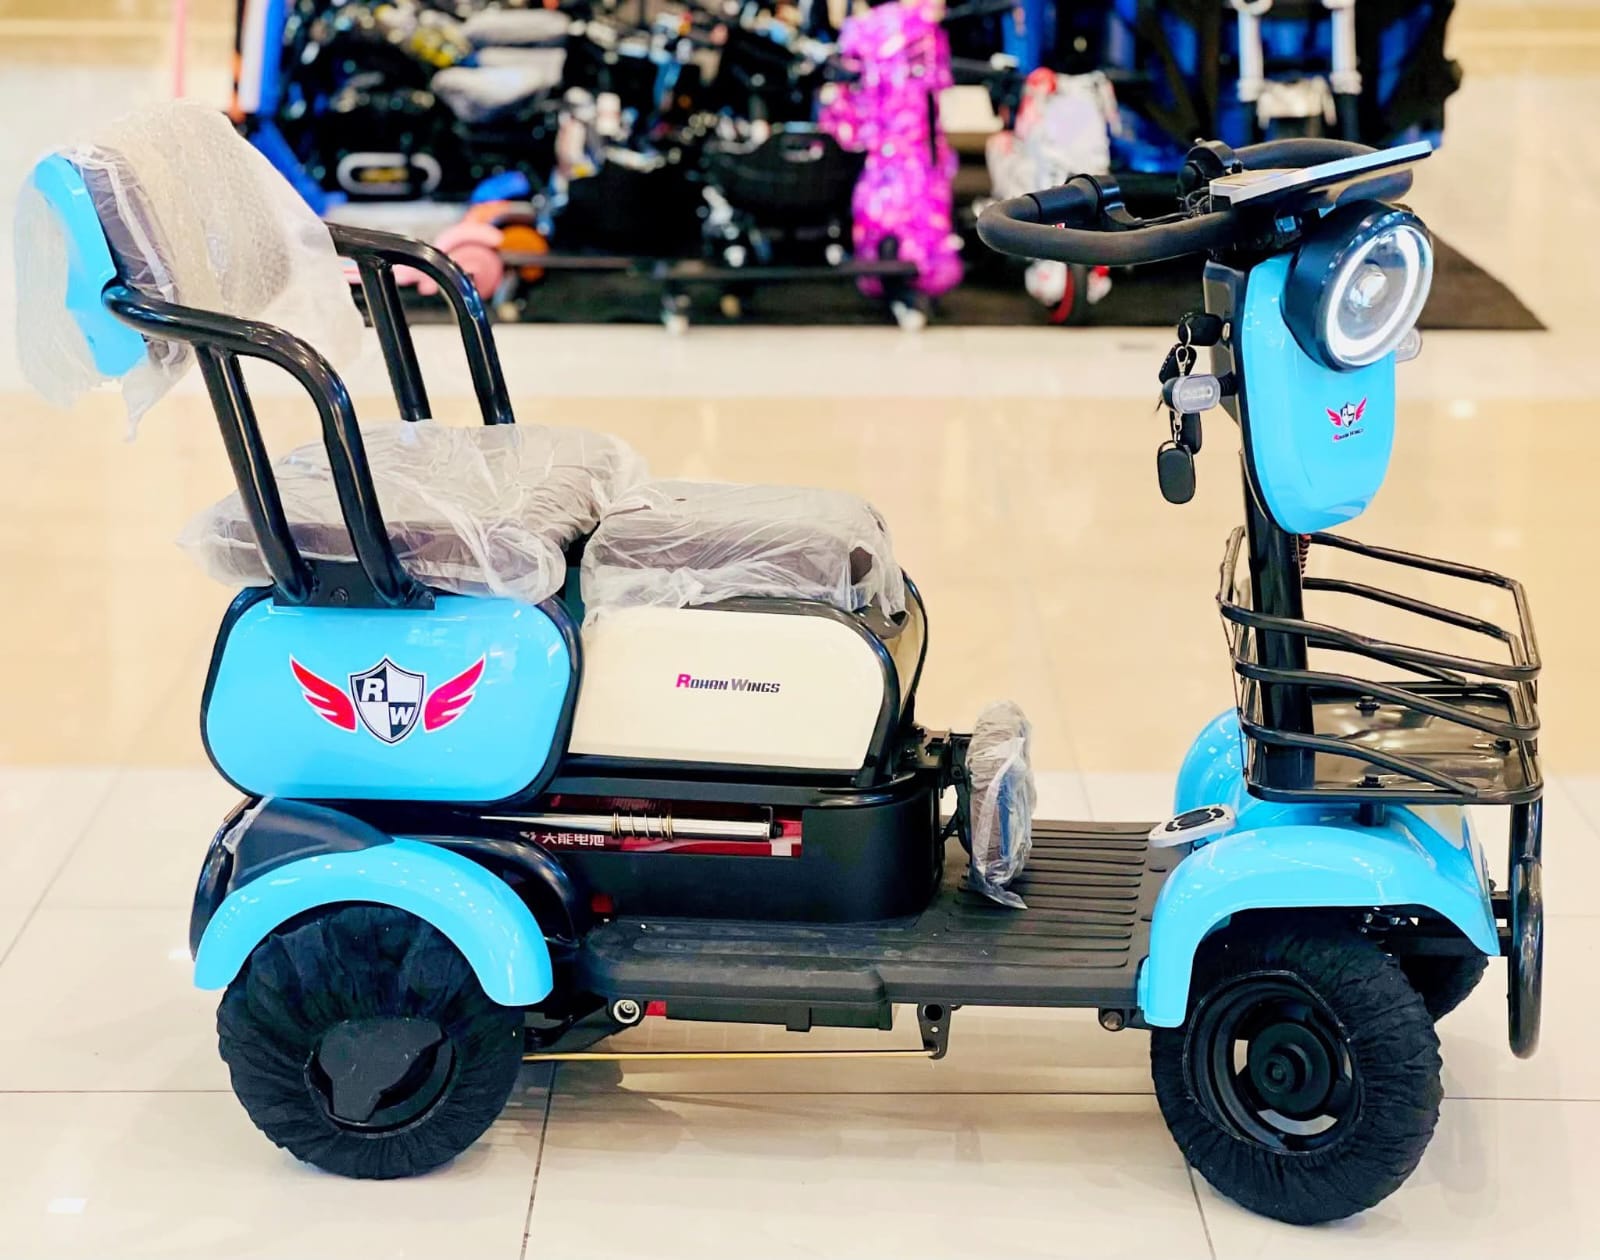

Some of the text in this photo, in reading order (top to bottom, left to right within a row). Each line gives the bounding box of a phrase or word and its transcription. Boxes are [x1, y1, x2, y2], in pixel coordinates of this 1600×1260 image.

[361, 677, 385, 702] R
[676, 673, 780, 693] ROHAN WINGS
[389, 706, 415, 725] W
